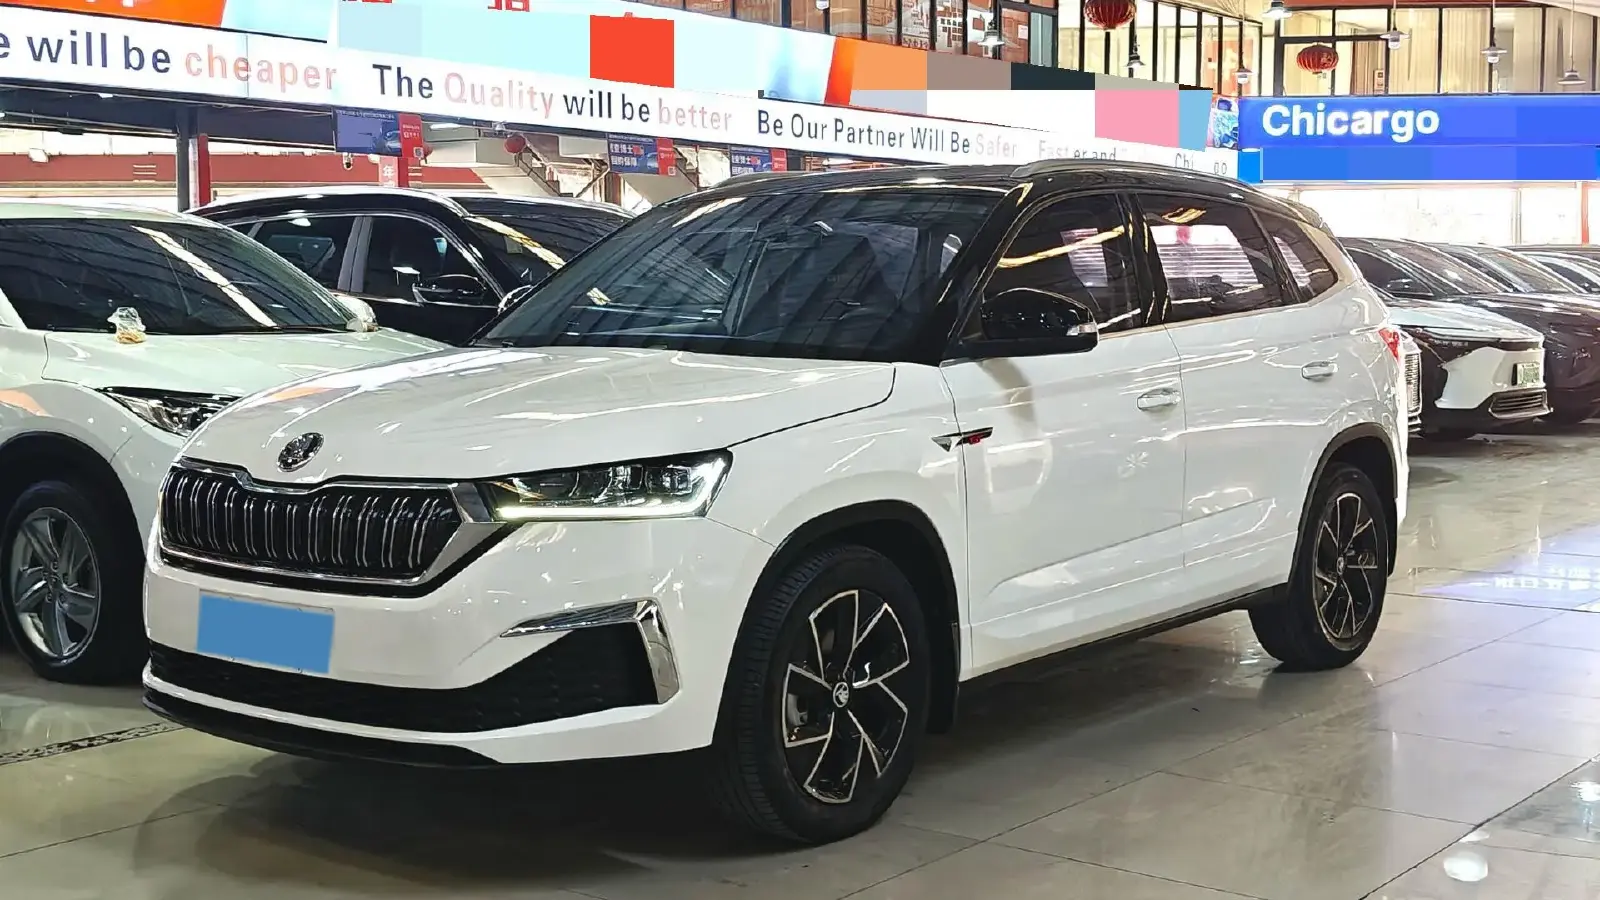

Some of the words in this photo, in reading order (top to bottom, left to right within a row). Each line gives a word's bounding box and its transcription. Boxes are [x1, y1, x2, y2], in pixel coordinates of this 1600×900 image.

[27, 30, 107, 68] will
[124, 35, 171, 73] be
[185, 45, 337, 92] cheaper
[372, 64, 433, 99] The
[444, 72, 554, 118] Quality
[563, 90, 612, 119] will
[621, 94, 650, 123] be
[658, 98, 732, 132] better
[1262, 103, 1440, 143] Chicargo
[757, 110, 783, 136] Be
[790, 114, 827, 141] Our
[834, 118, 905, 149] Partner
[911, 126, 944, 153] Will
[950, 131, 970, 153] Be
[976, 133, 1017, 157] Safer
